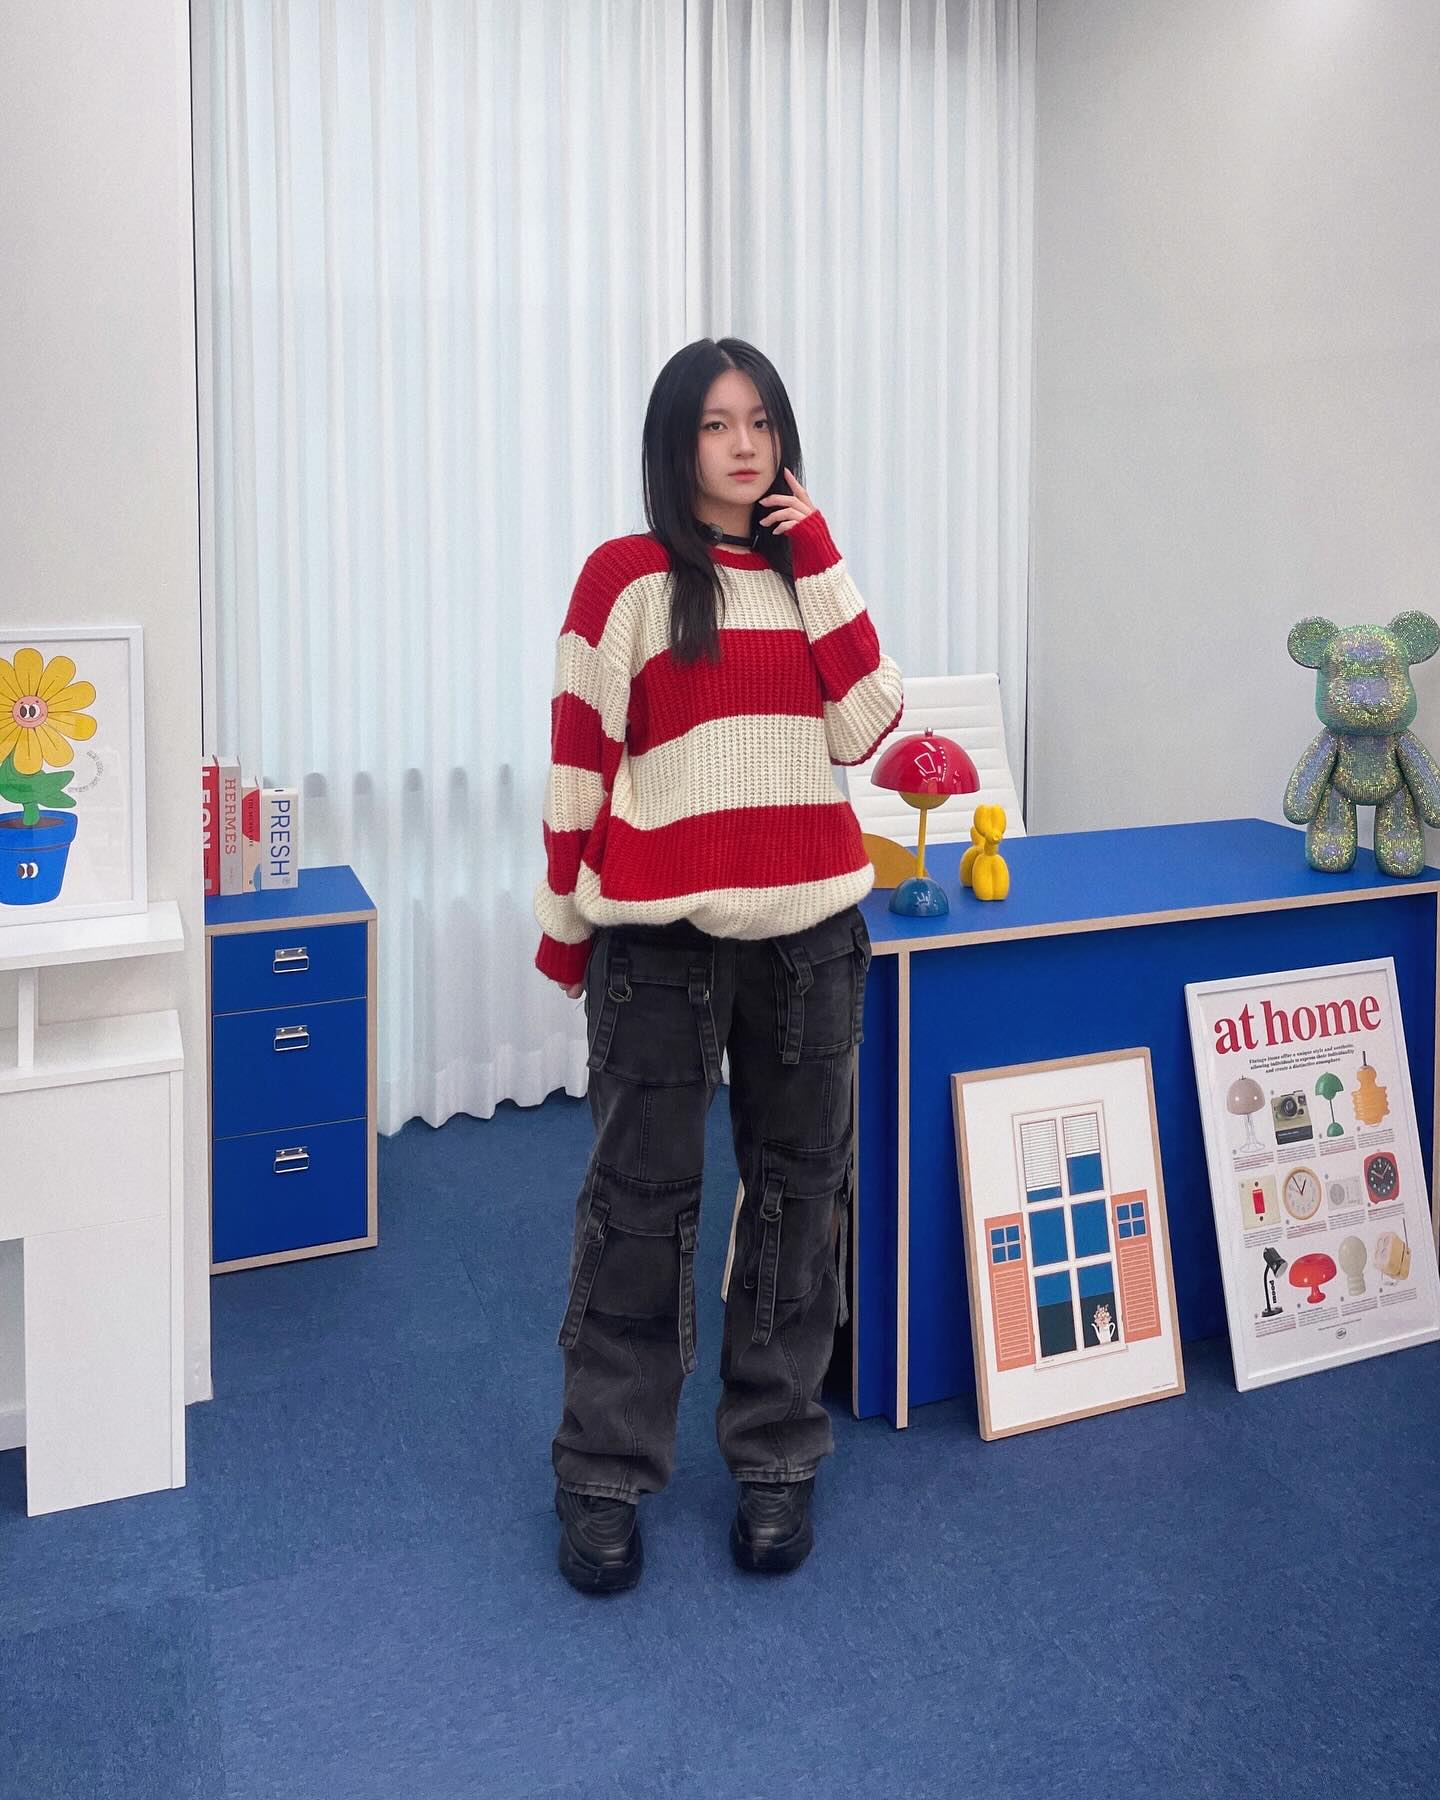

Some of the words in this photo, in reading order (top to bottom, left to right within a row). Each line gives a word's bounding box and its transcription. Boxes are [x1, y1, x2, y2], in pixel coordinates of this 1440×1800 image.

[225, 778, 237, 855] HERMES
[270, 799, 290, 876] PRESH
[1214, 1003, 1259, 1054] at
[1260, 995, 1382, 1046] home
